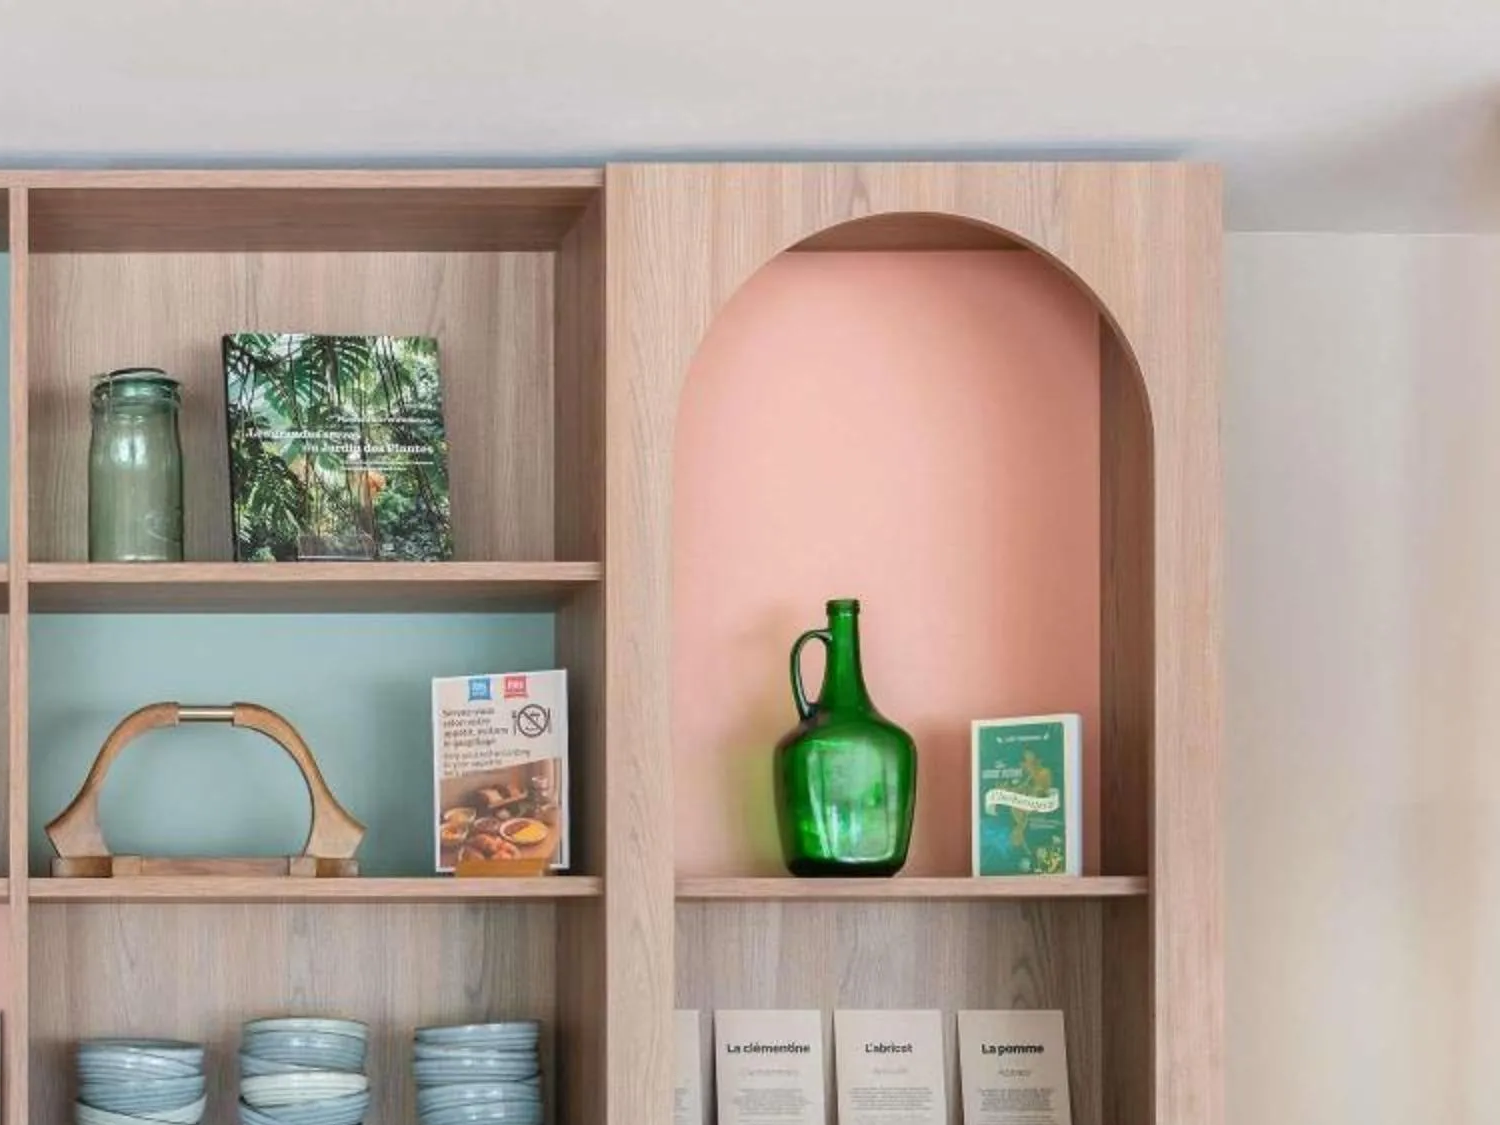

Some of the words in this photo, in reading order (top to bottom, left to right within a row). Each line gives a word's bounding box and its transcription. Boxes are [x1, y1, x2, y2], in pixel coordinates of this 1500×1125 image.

[726, 1043, 741, 1054] La
[743, 1041, 811, 1054] clémentine
[864, 1042, 913, 1053] L'abricot
[981, 1043, 996, 1054] La
[997, 1044, 1045, 1056] pomme
